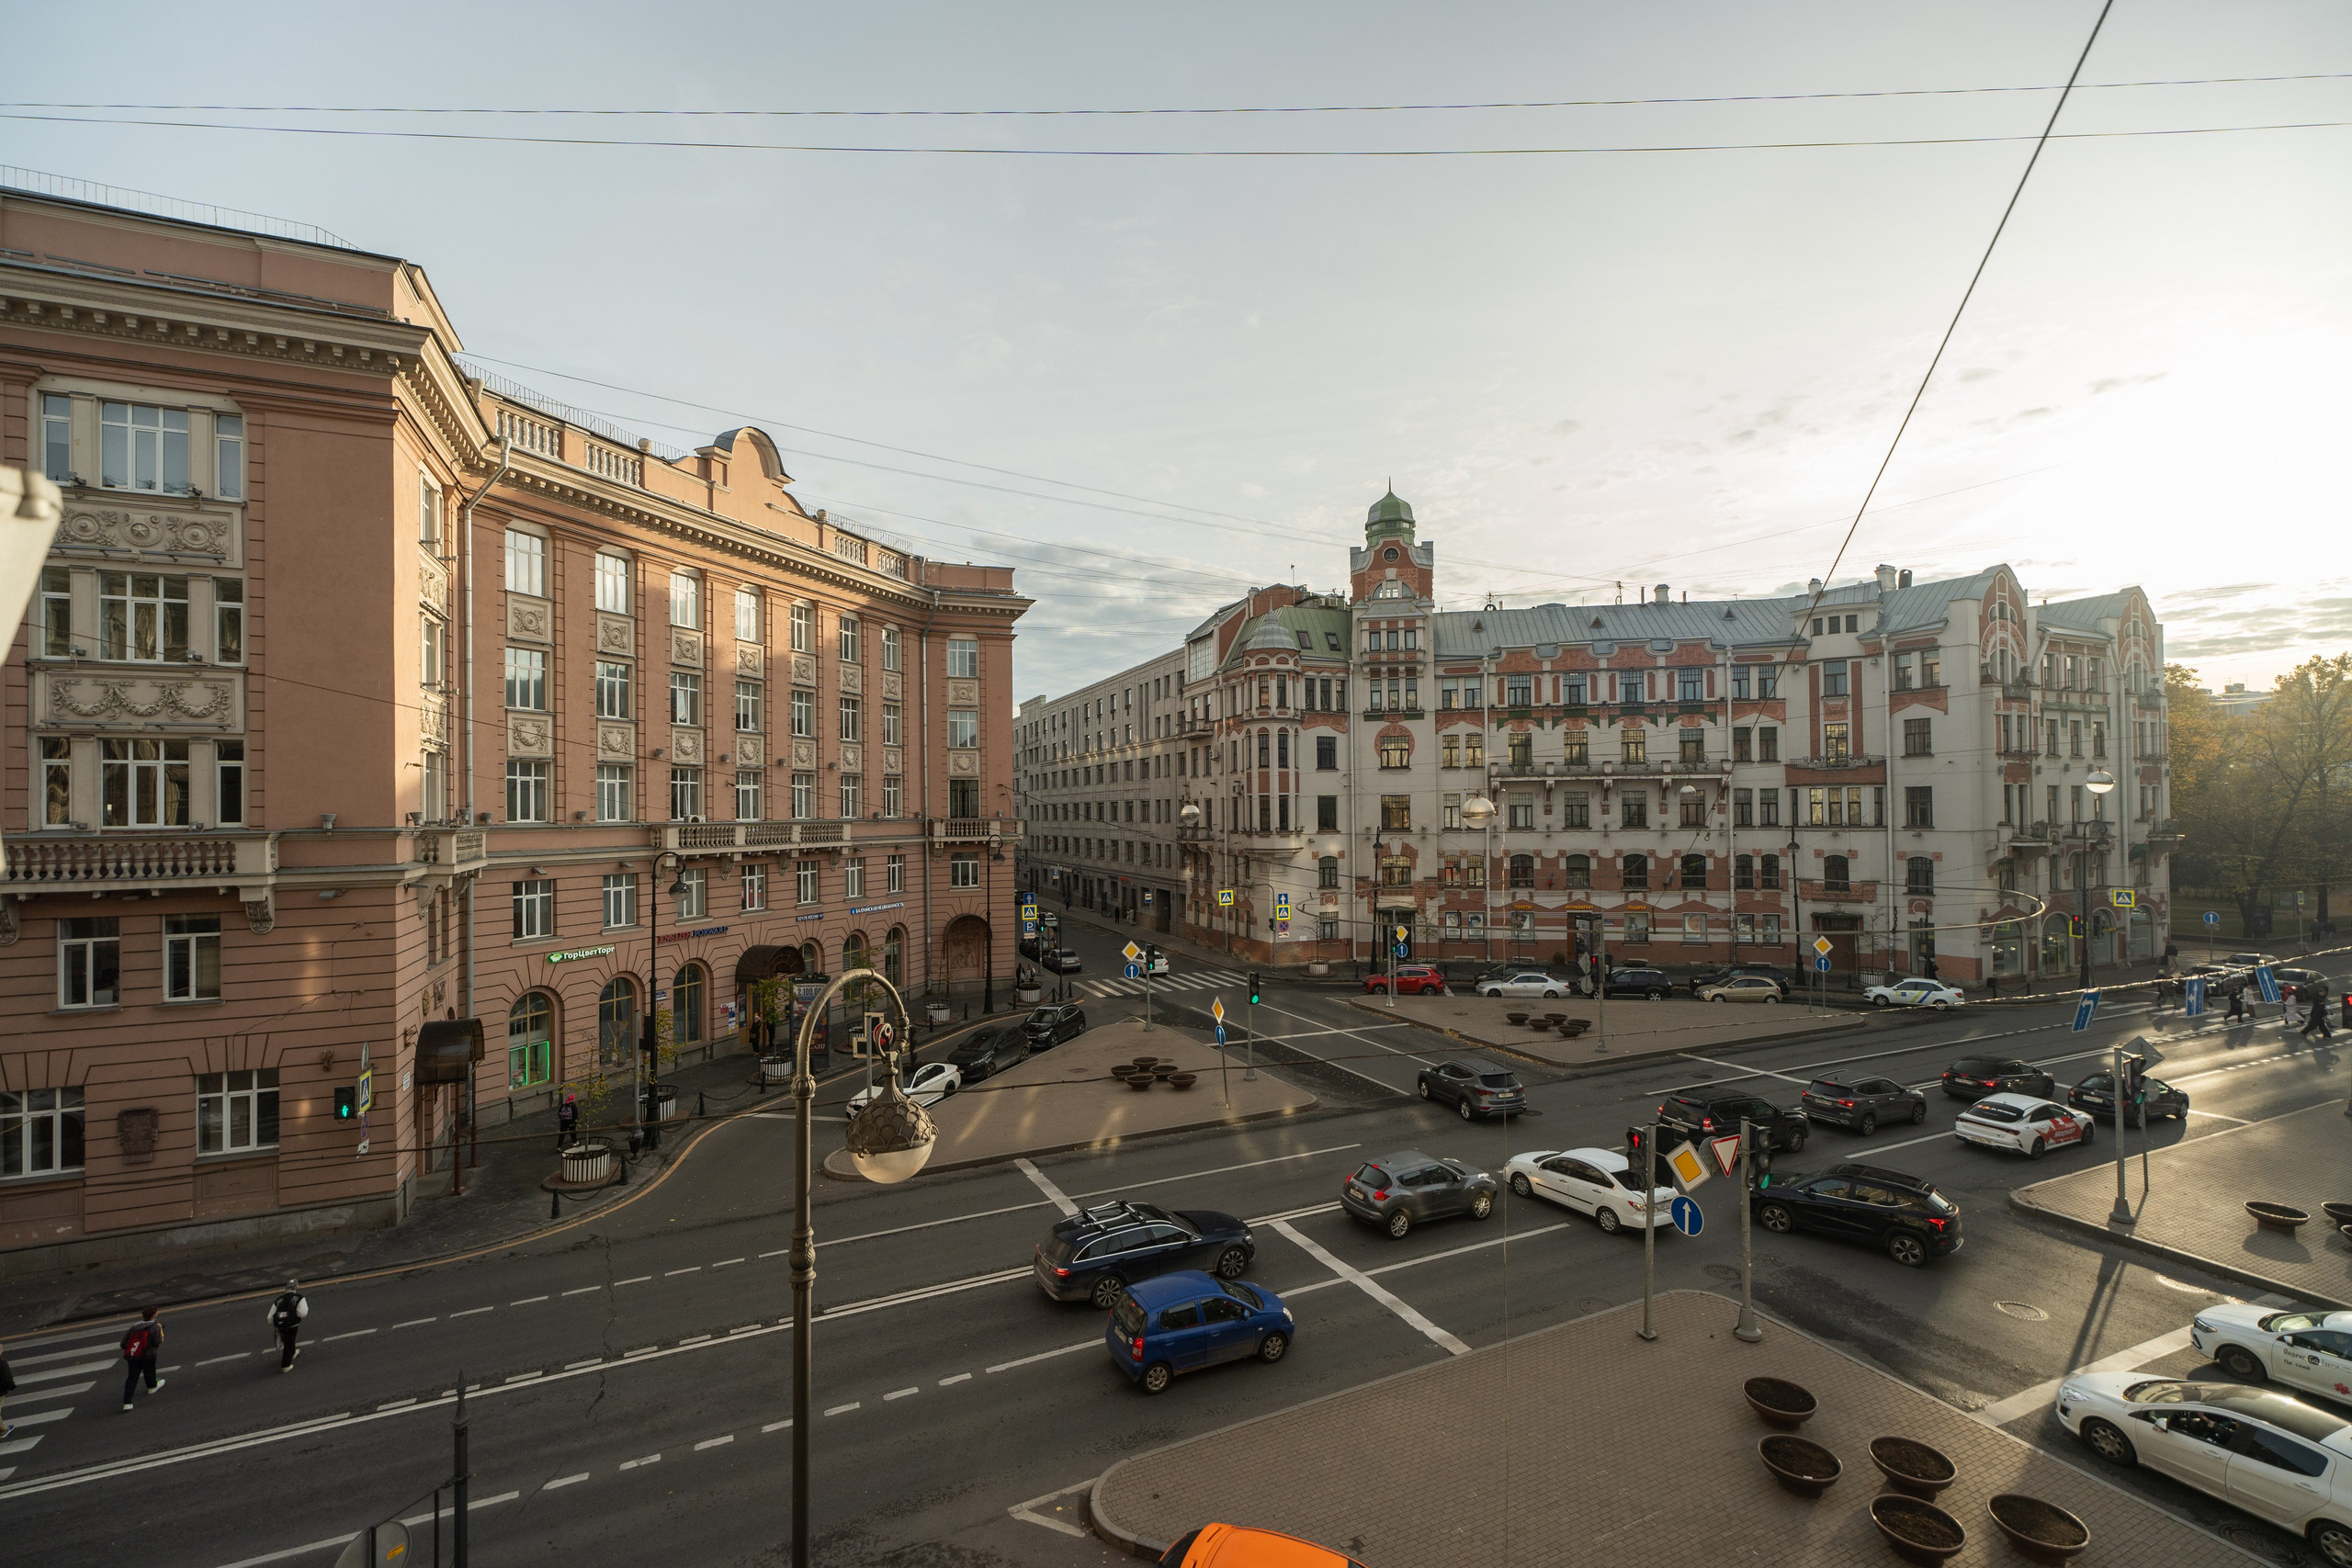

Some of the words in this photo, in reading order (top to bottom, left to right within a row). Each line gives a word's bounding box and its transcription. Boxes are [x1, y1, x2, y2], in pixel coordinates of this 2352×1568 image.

[659, 931, 691, 943] ENGLISH
[694, 926, 729, 937] FORWARD
[563, 946, 616, 960] ГорЦветТорг
[2283, 1348, 2306, 1360] Яндекс
[2309, 1355, 2319, 1365] Go
[2321, 1359, 2339, 1371] Такси
